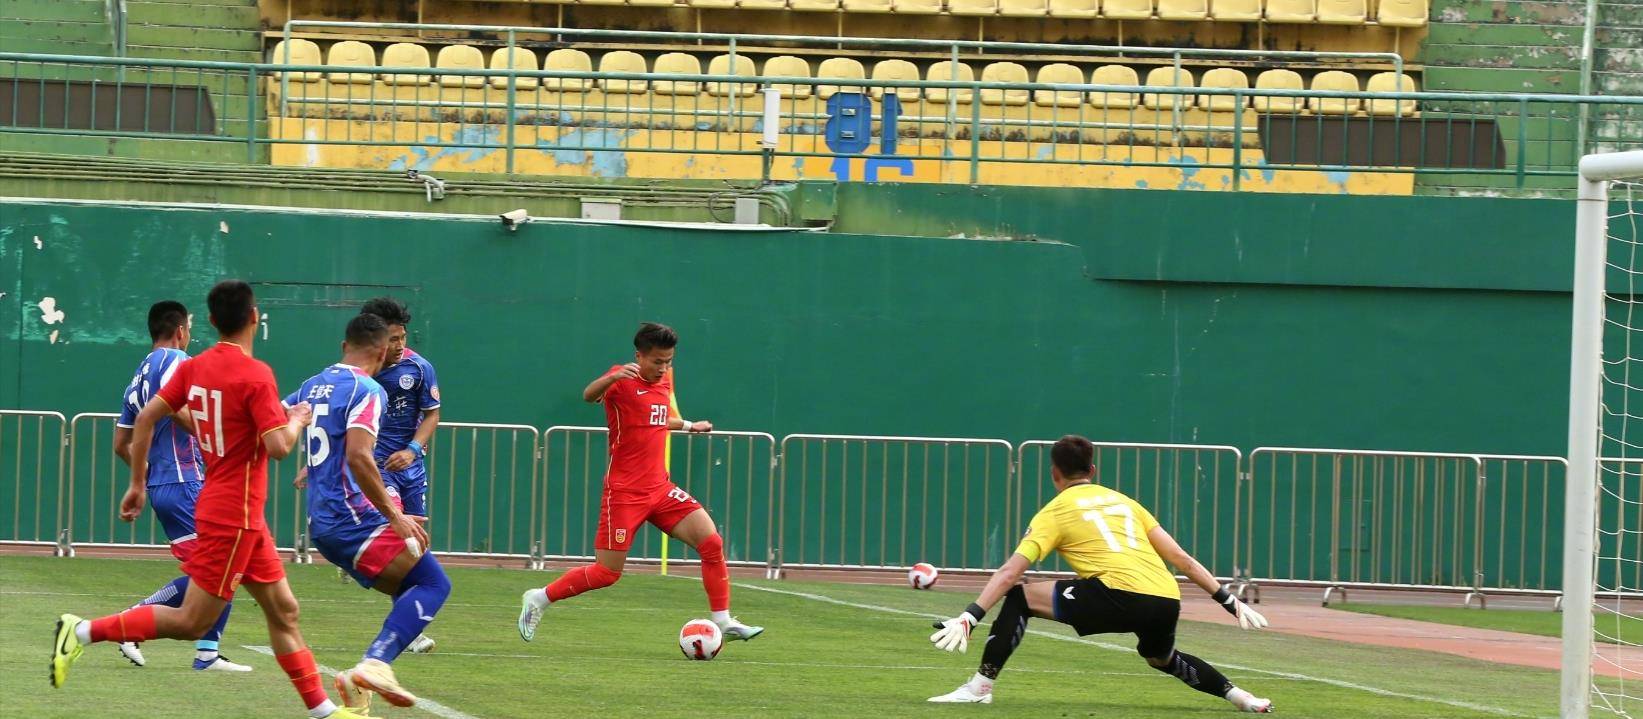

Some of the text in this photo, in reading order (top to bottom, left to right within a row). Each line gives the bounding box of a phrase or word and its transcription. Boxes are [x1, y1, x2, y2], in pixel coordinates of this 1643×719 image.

[187, 385, 224, 457] 21
[650, 404, 667, 425] 20
[1083, 503, 1137, 552] 17
